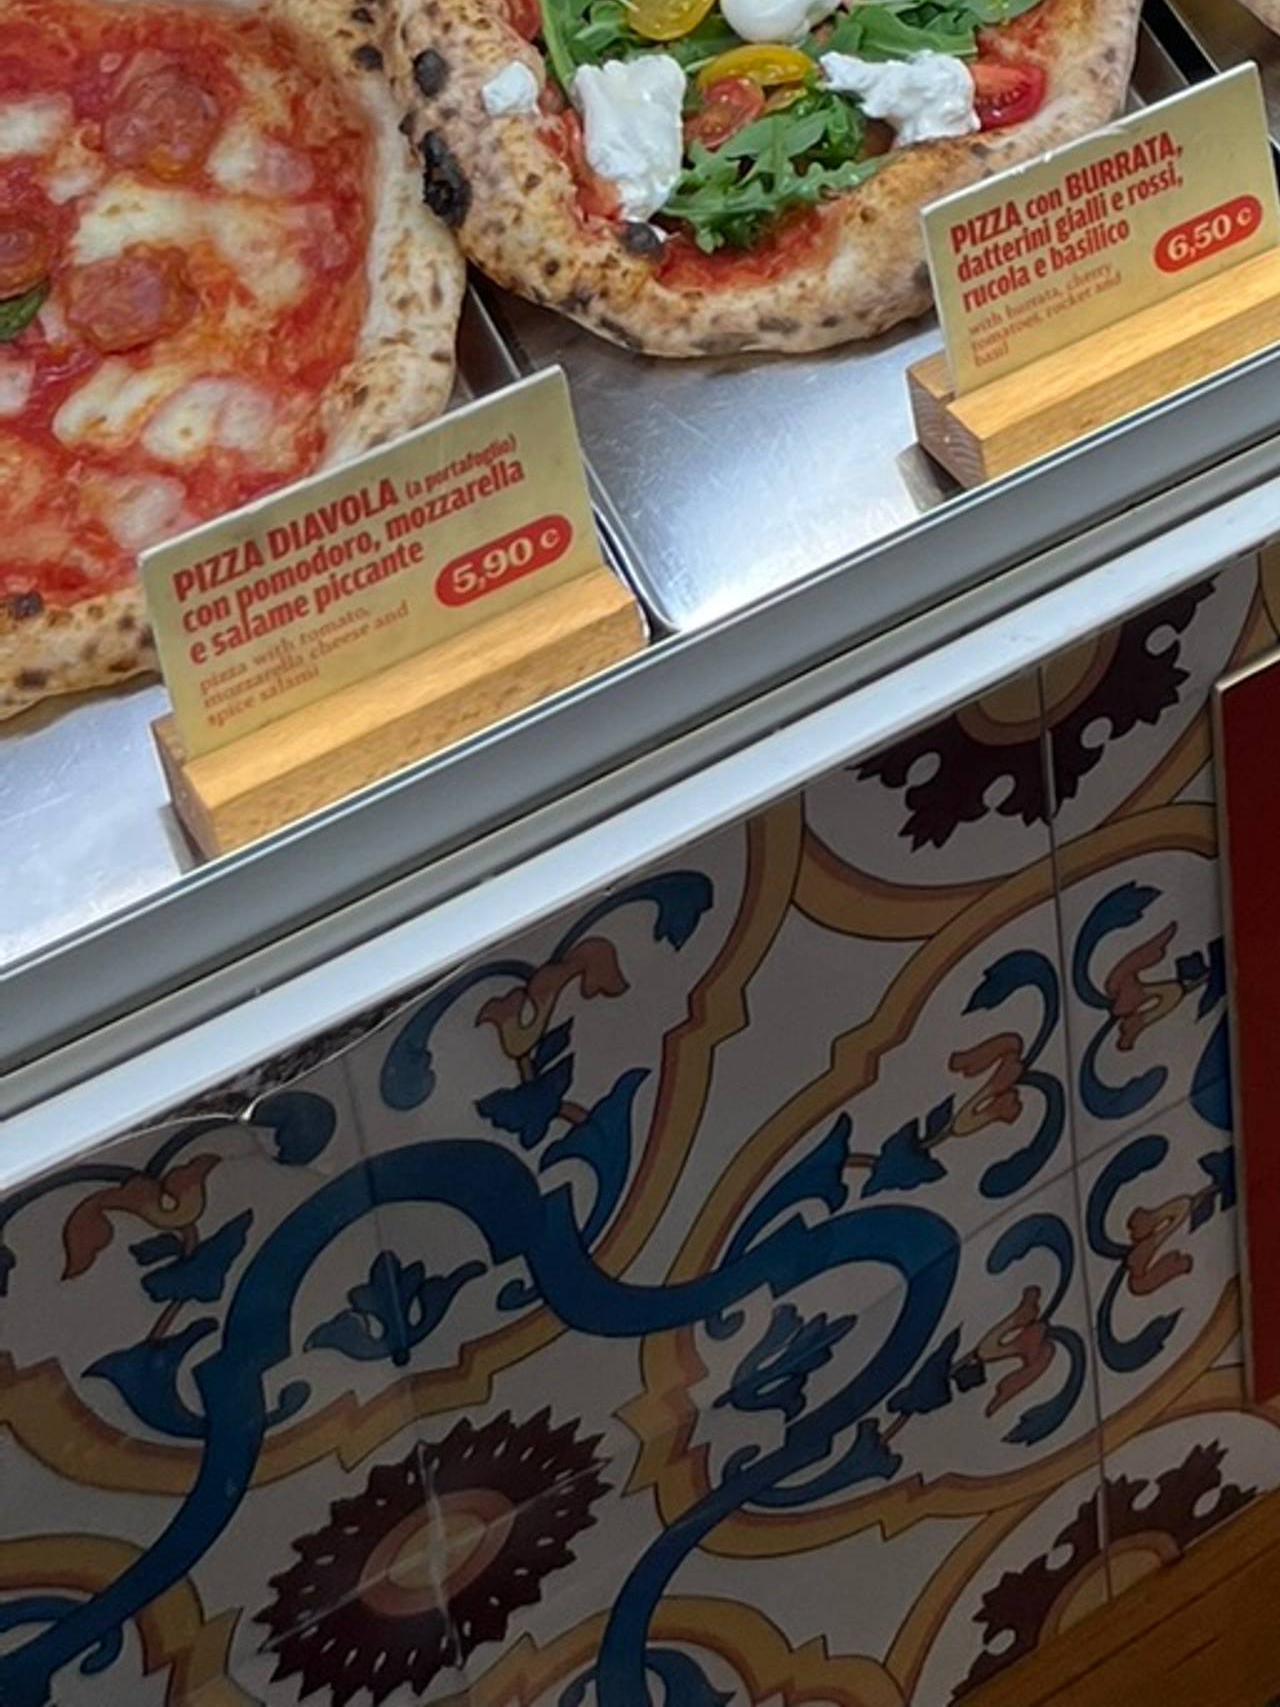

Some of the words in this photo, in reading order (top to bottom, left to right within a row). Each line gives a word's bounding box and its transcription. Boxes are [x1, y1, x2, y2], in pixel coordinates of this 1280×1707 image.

[950, 201, 1022, 255] PIZZA
[1026, 186, 1062, 221] con
[1064, 130, 1184, 202] BURRATA,
[957, 220, 1052, 283] datterini
[1055, 191, 1108, 244] gialli
[1111, 191, 1124, 212] e
[1127, 161, 1184, 207] rossi,
[1167, 217, 1233, 264] 6,50
[962, 263, 1031, 314] rucola
[1035, 256, 1047, 277] e
[1050, 218, 1131, 272] basilico
[172, 540, 265, 604] PIZZA
[267, 477, 400, 562] DIAVOLA
[405, 471, 423, 502] (a
[426, 433, 518, 494] portafoglio)
[182, 595, 233, 634] con
[234, 531, 381, 623] pomodoro,
[385, 457, 525, 538] mozzarella
[452, 541, 534, 594] 5,90
[189, 638, 208, 666] e
[212, 595, 309, 656] salame
[314, 538, 425, 615] piccante
[204, 649, 305, 708] mozzarella
[308, 619, 372, 664] cheese
[375, 598, 411, 630] and
[202, 660, 248, 697] pizza
[252, 637, 297, 669] with
[259, 665, 321, 705] salami
